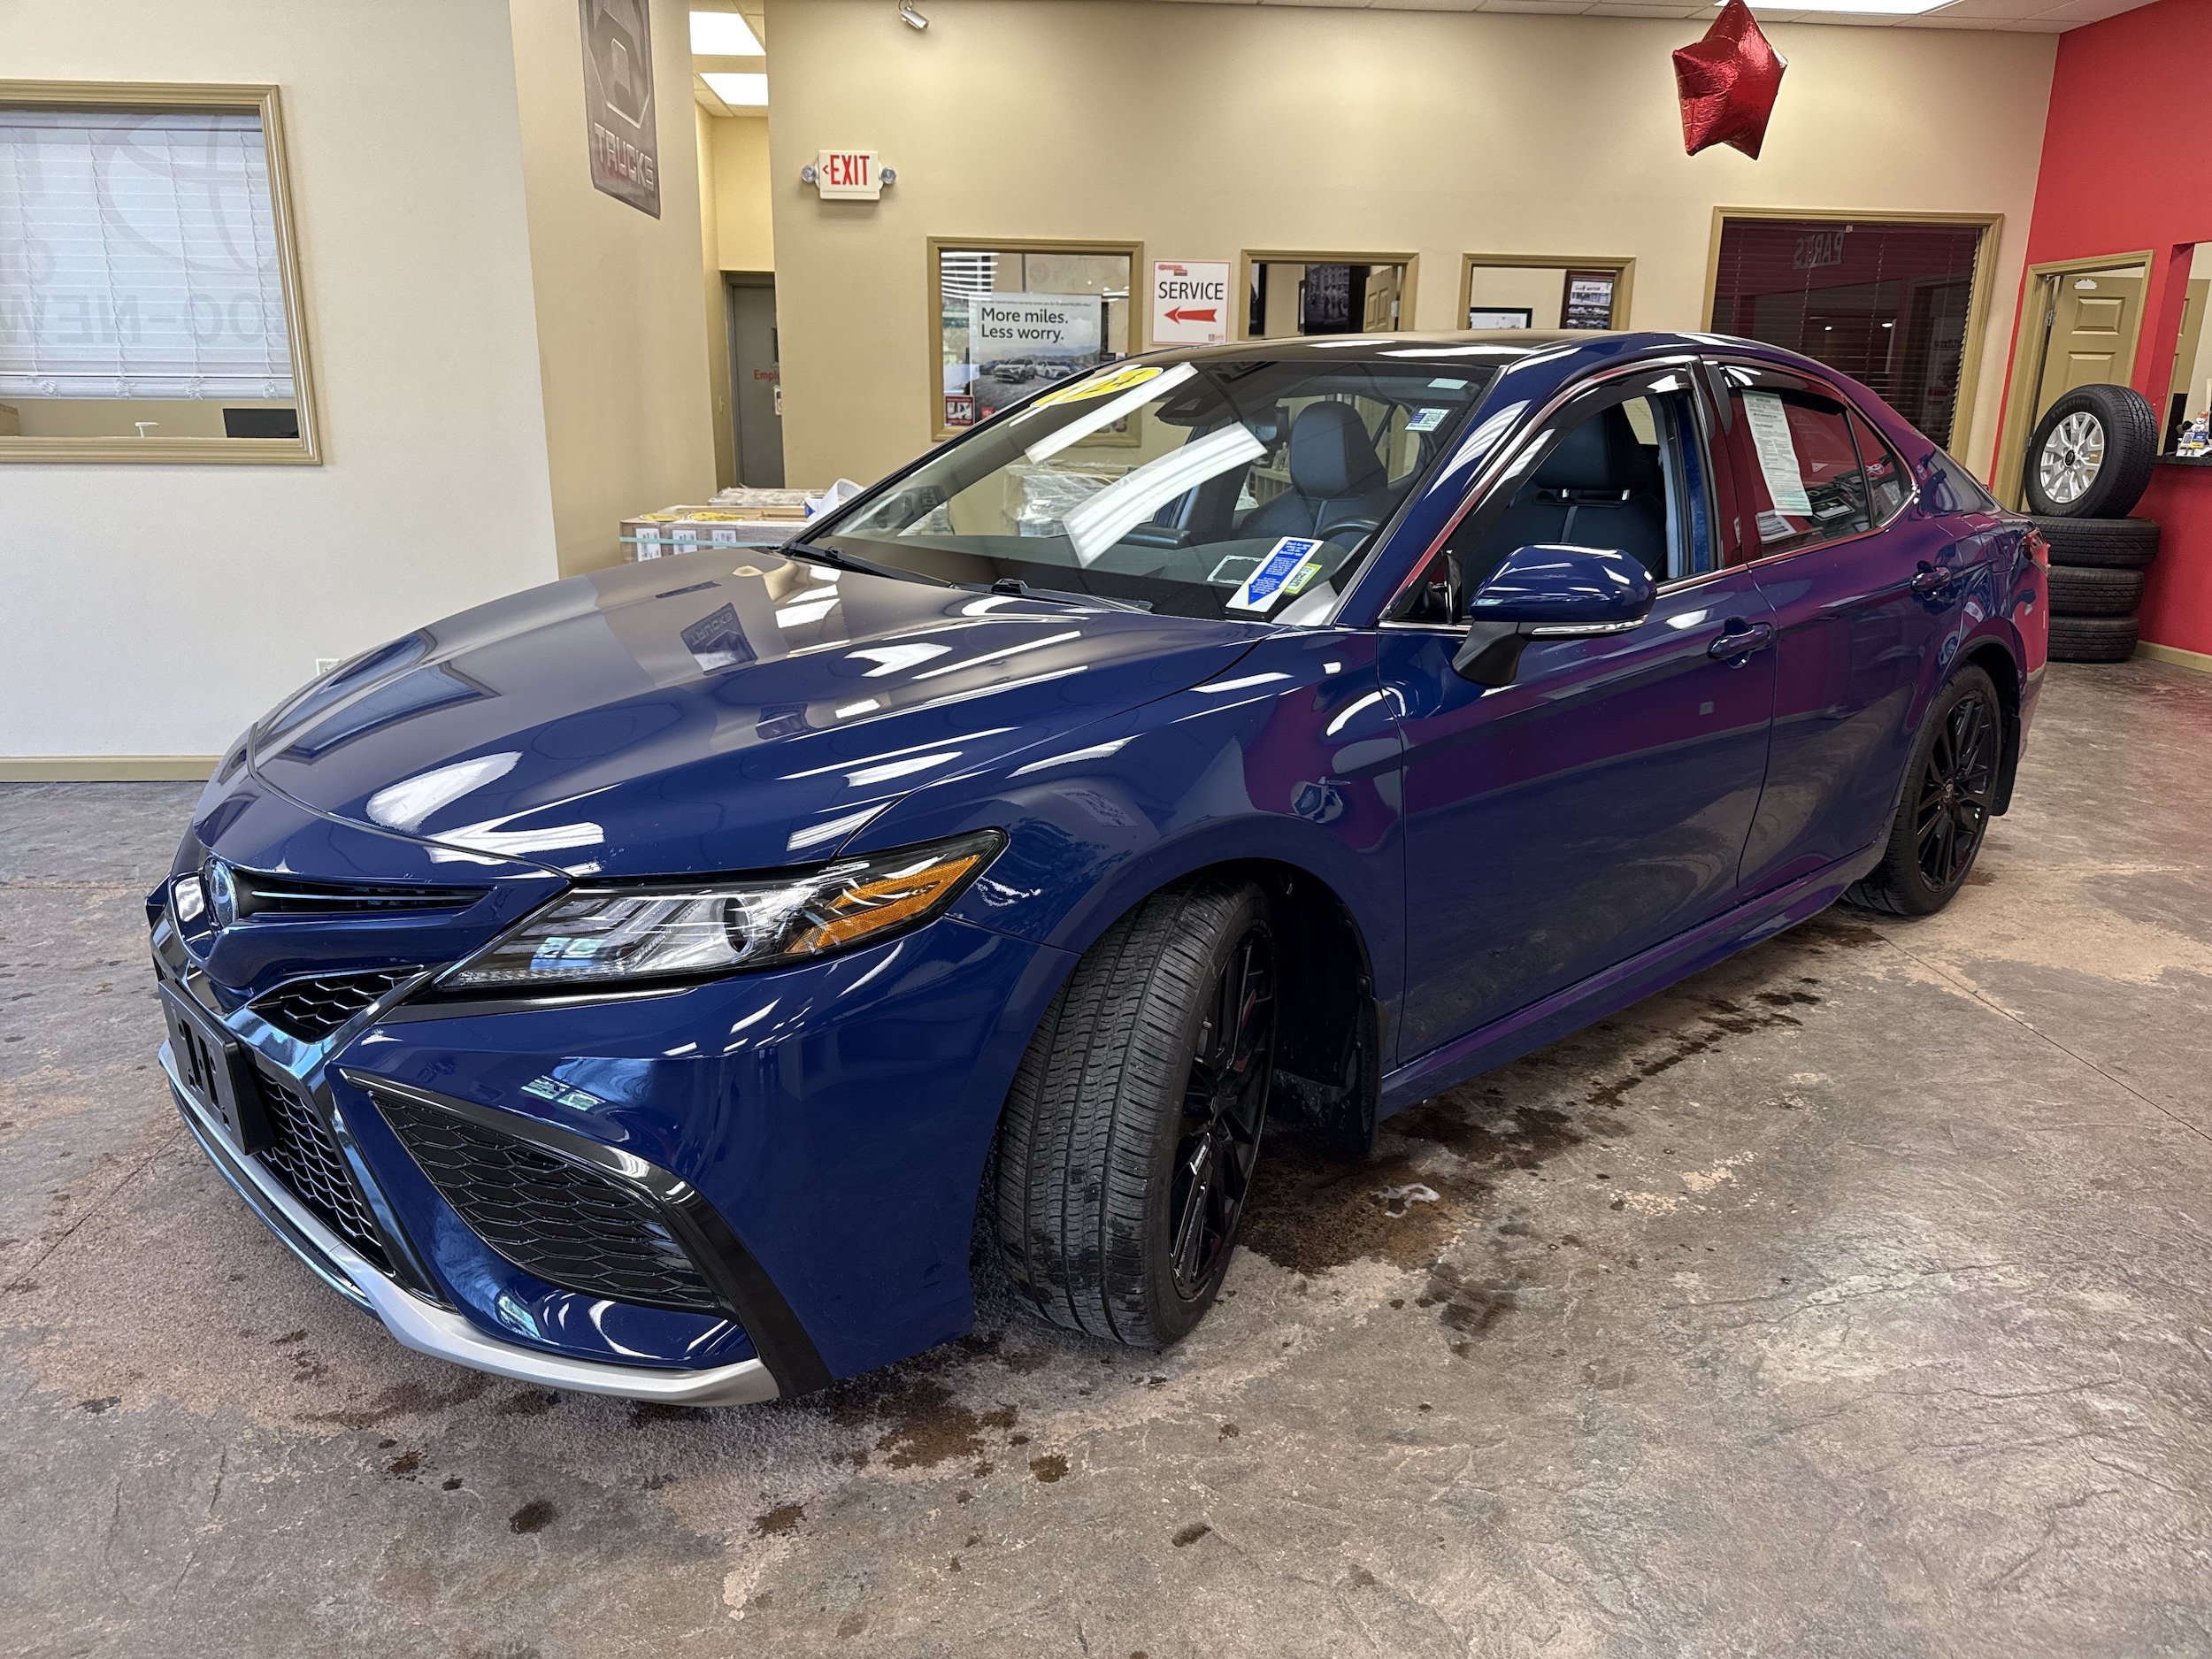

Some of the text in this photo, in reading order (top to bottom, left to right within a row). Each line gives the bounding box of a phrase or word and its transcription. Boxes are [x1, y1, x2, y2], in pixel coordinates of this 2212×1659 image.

[594, 122, 654, 191] TRUCKS
[830, 155, 870, 185] EXIT
[1158, 281, 1225, 300] SERVICE
[981, 307, 1069, 324] More miles.
[981, 324, 1064, 343] Less worry.
